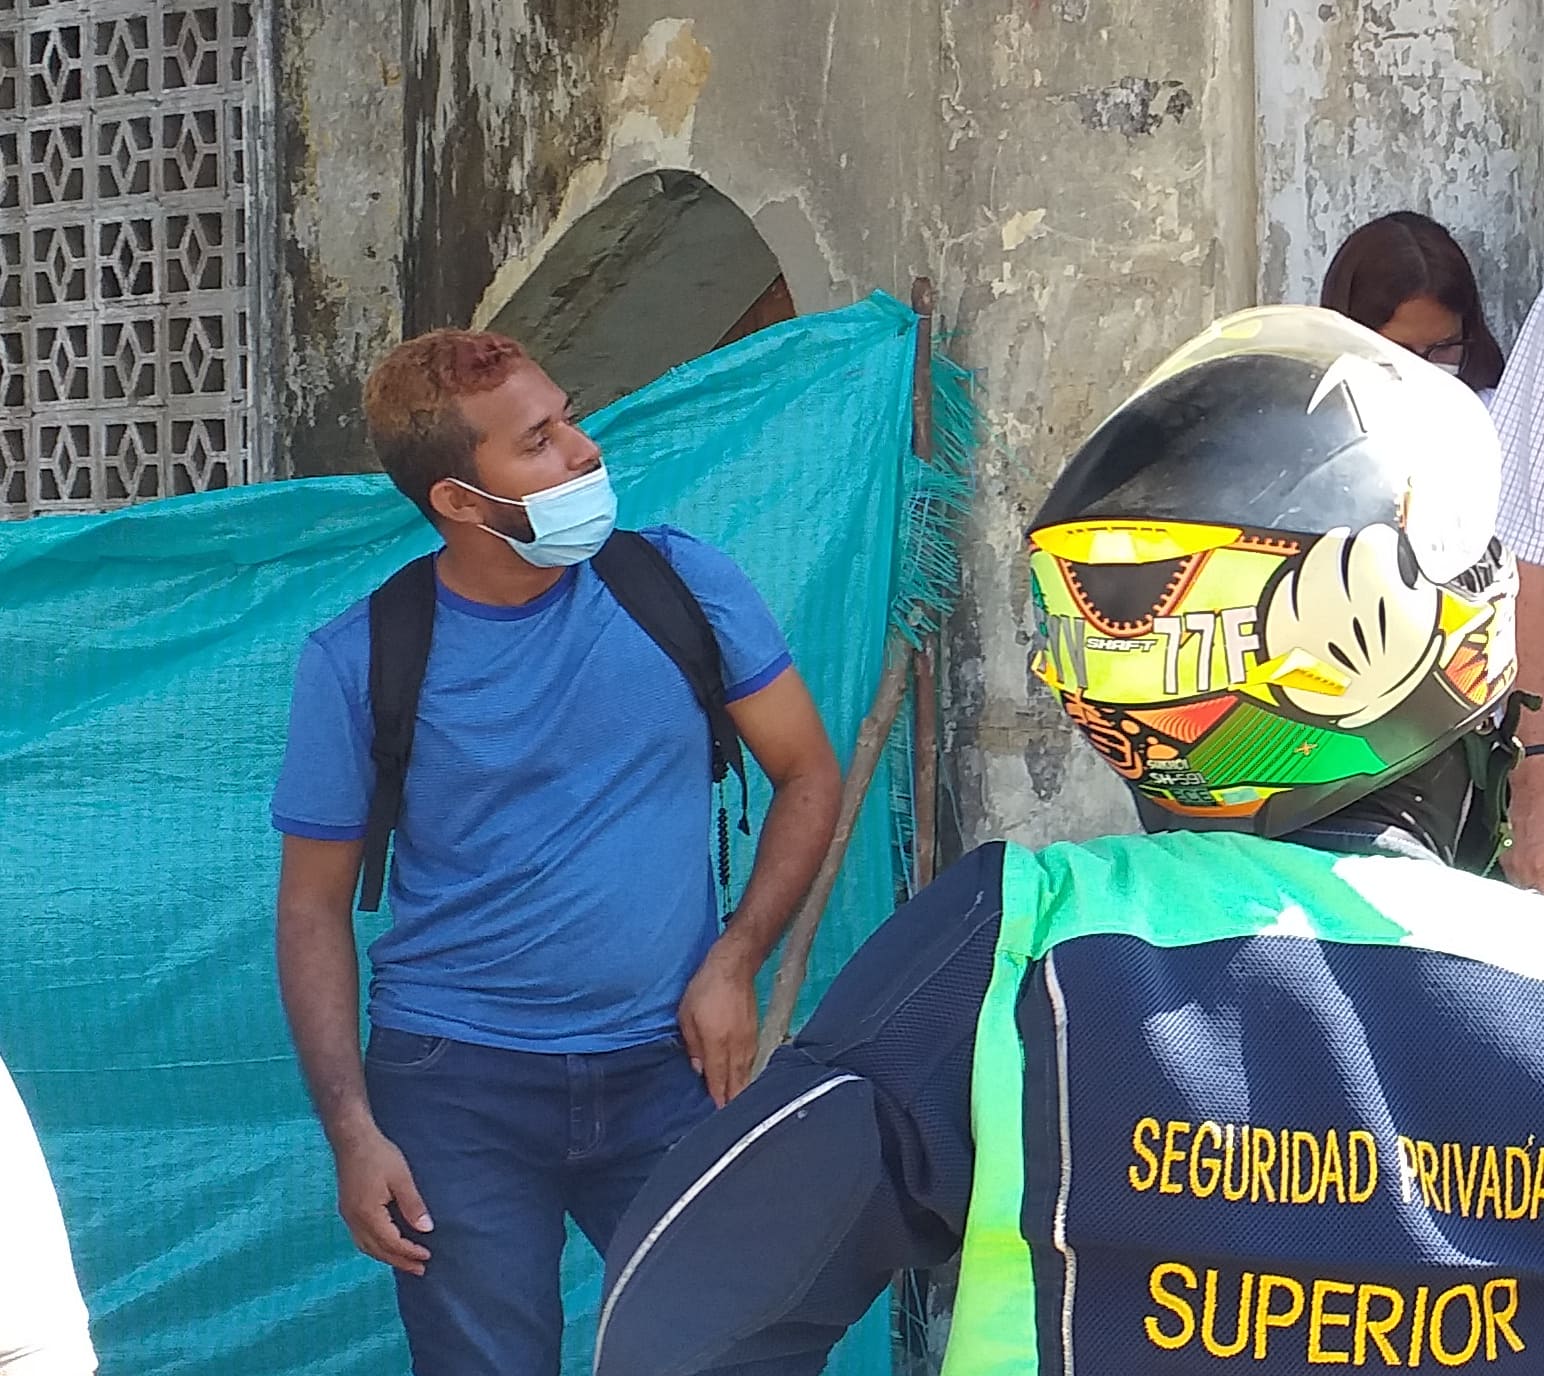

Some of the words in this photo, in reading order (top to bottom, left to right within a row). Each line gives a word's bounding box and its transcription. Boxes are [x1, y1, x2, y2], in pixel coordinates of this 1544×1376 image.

[1086, 636, 1159, 652] SHAFT
[1128, 1117, 1379, 1204] SEGURIDAD
[1144, 1262, 1526, 1367] SUPERIOR
